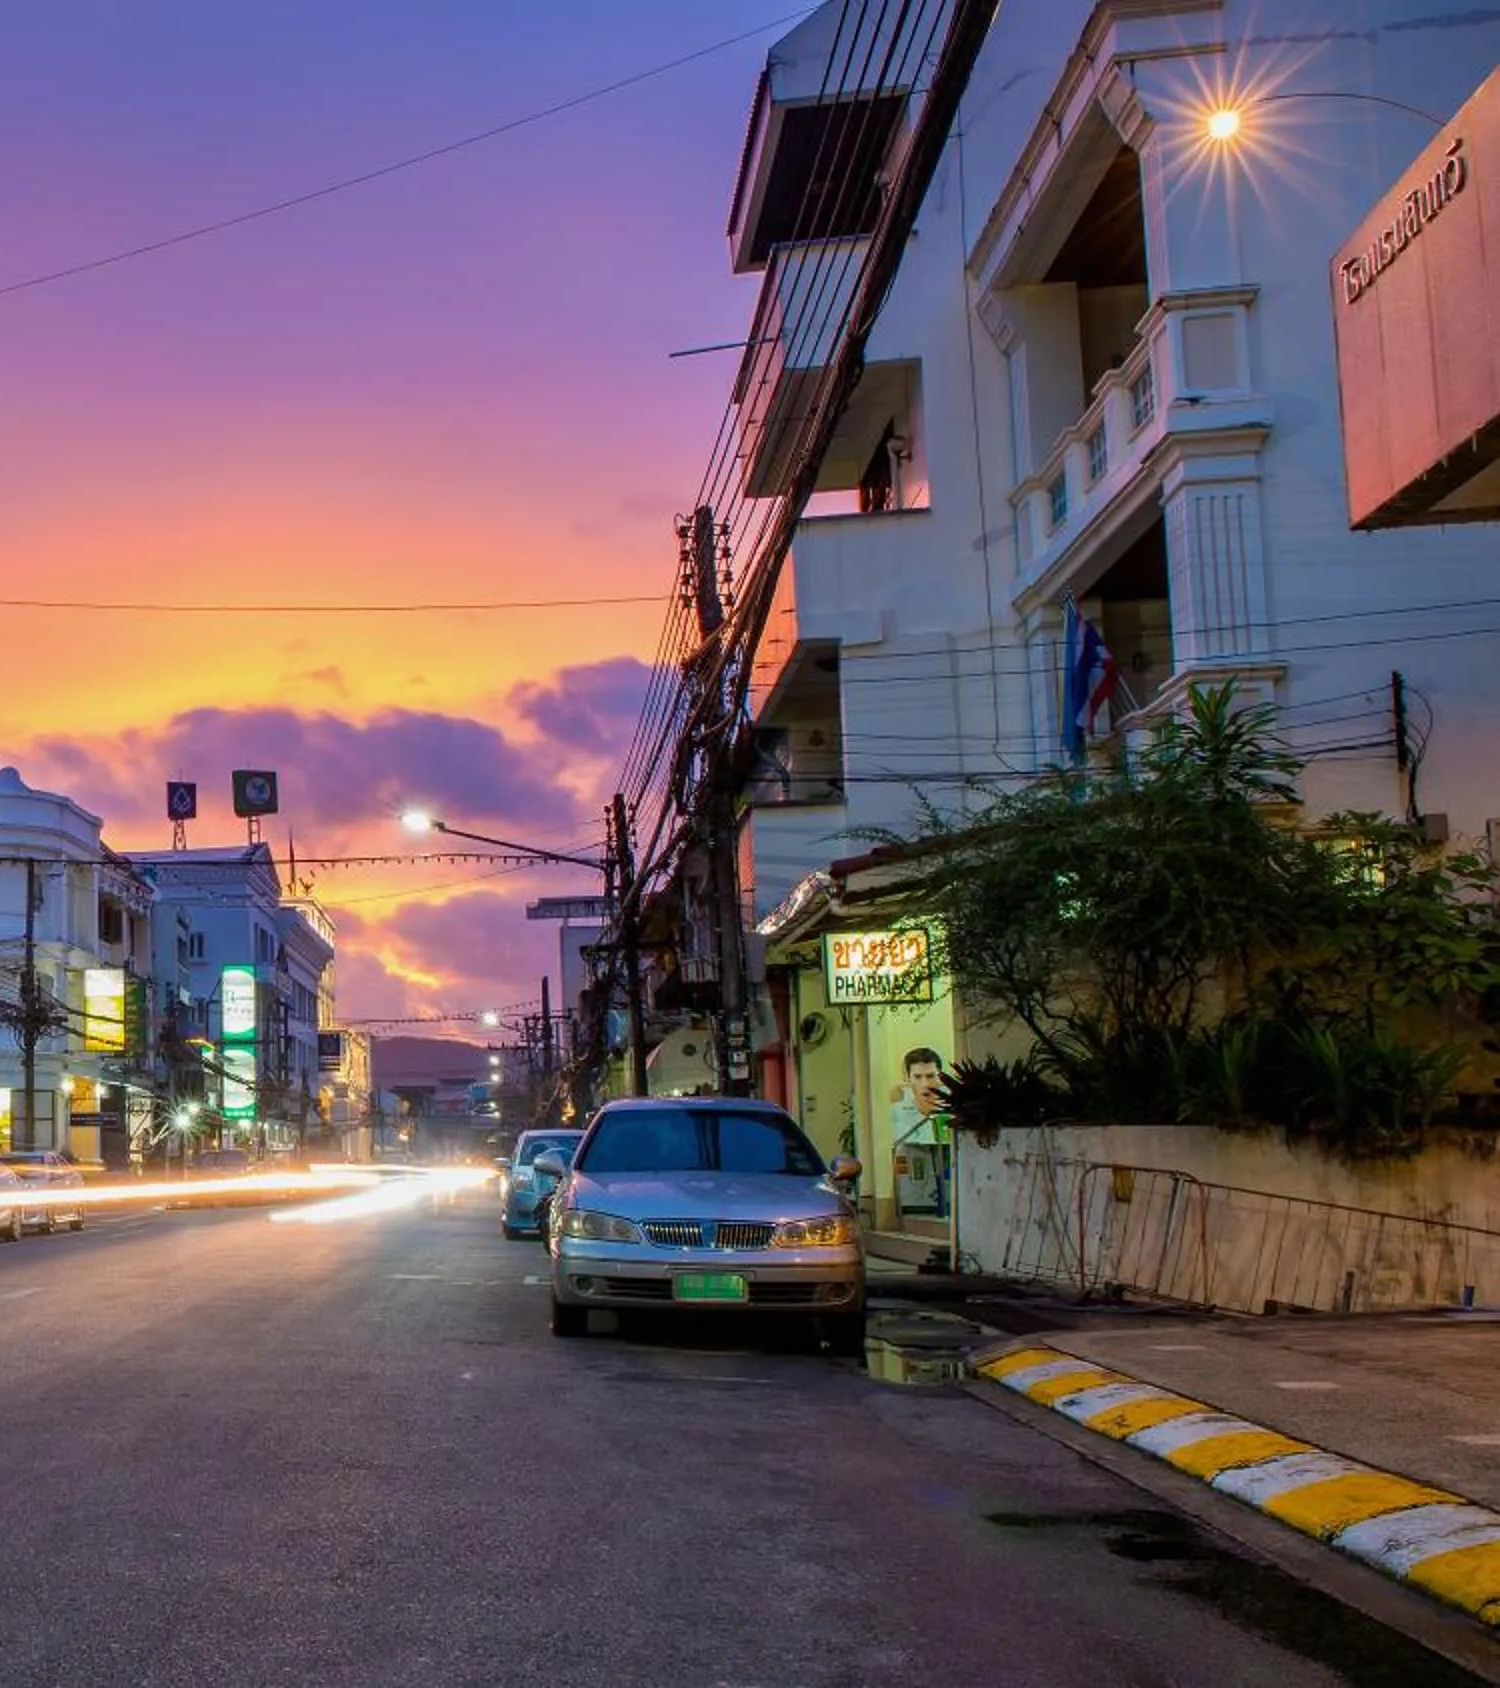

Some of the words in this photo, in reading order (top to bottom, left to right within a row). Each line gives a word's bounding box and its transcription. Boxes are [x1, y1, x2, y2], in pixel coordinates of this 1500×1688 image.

[1340, 138, 1466, 304] โรงแรมสินทวี
